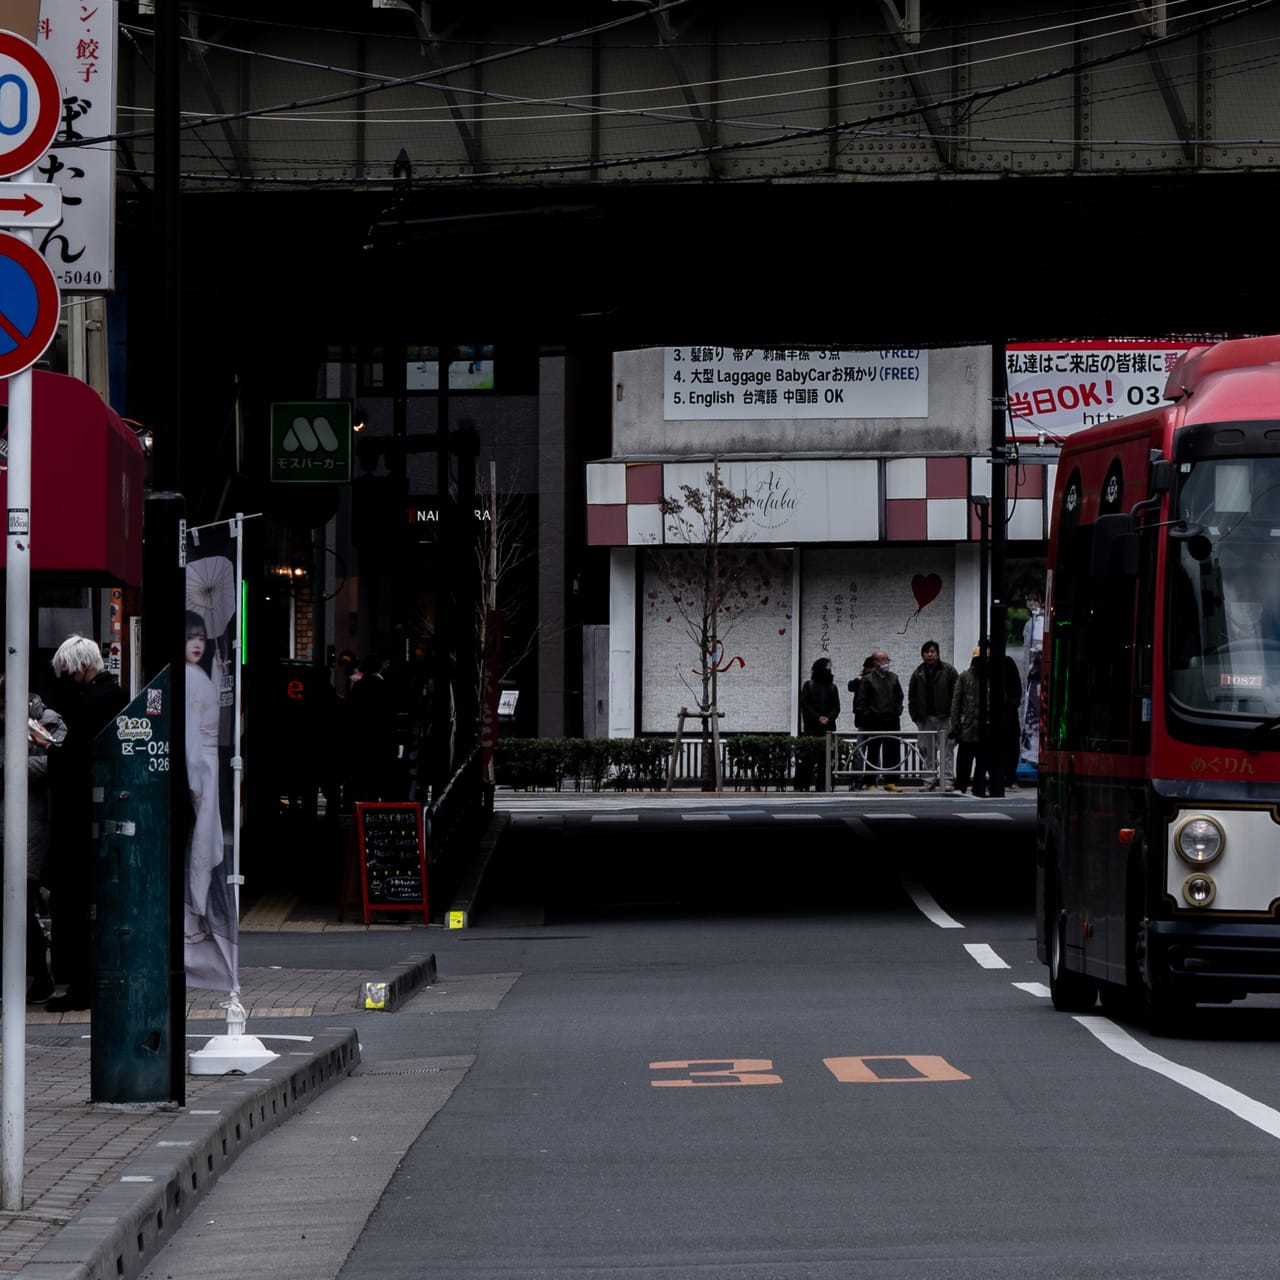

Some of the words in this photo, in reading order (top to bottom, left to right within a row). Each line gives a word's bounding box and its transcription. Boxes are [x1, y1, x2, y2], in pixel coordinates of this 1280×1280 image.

[53, 271, 103, 287] -5040
[673, 370, 686, 383] 4.
[690, 368, 715, 384] 大型
[717, 369, 772, 386] Laggage
[878, 366, 921, 382] (FREE)
[673, 392, 686, 405] 5.
[689, 391, 735, 407] English
[743, 389, 778, 405] 台湾語
[783, 388, 819, 405] 中国語
[824, 388, 844, 404] OK
[276, 456, 346, 471] モスバーガー
[1191, 755, 1257, 775] めぐりん
